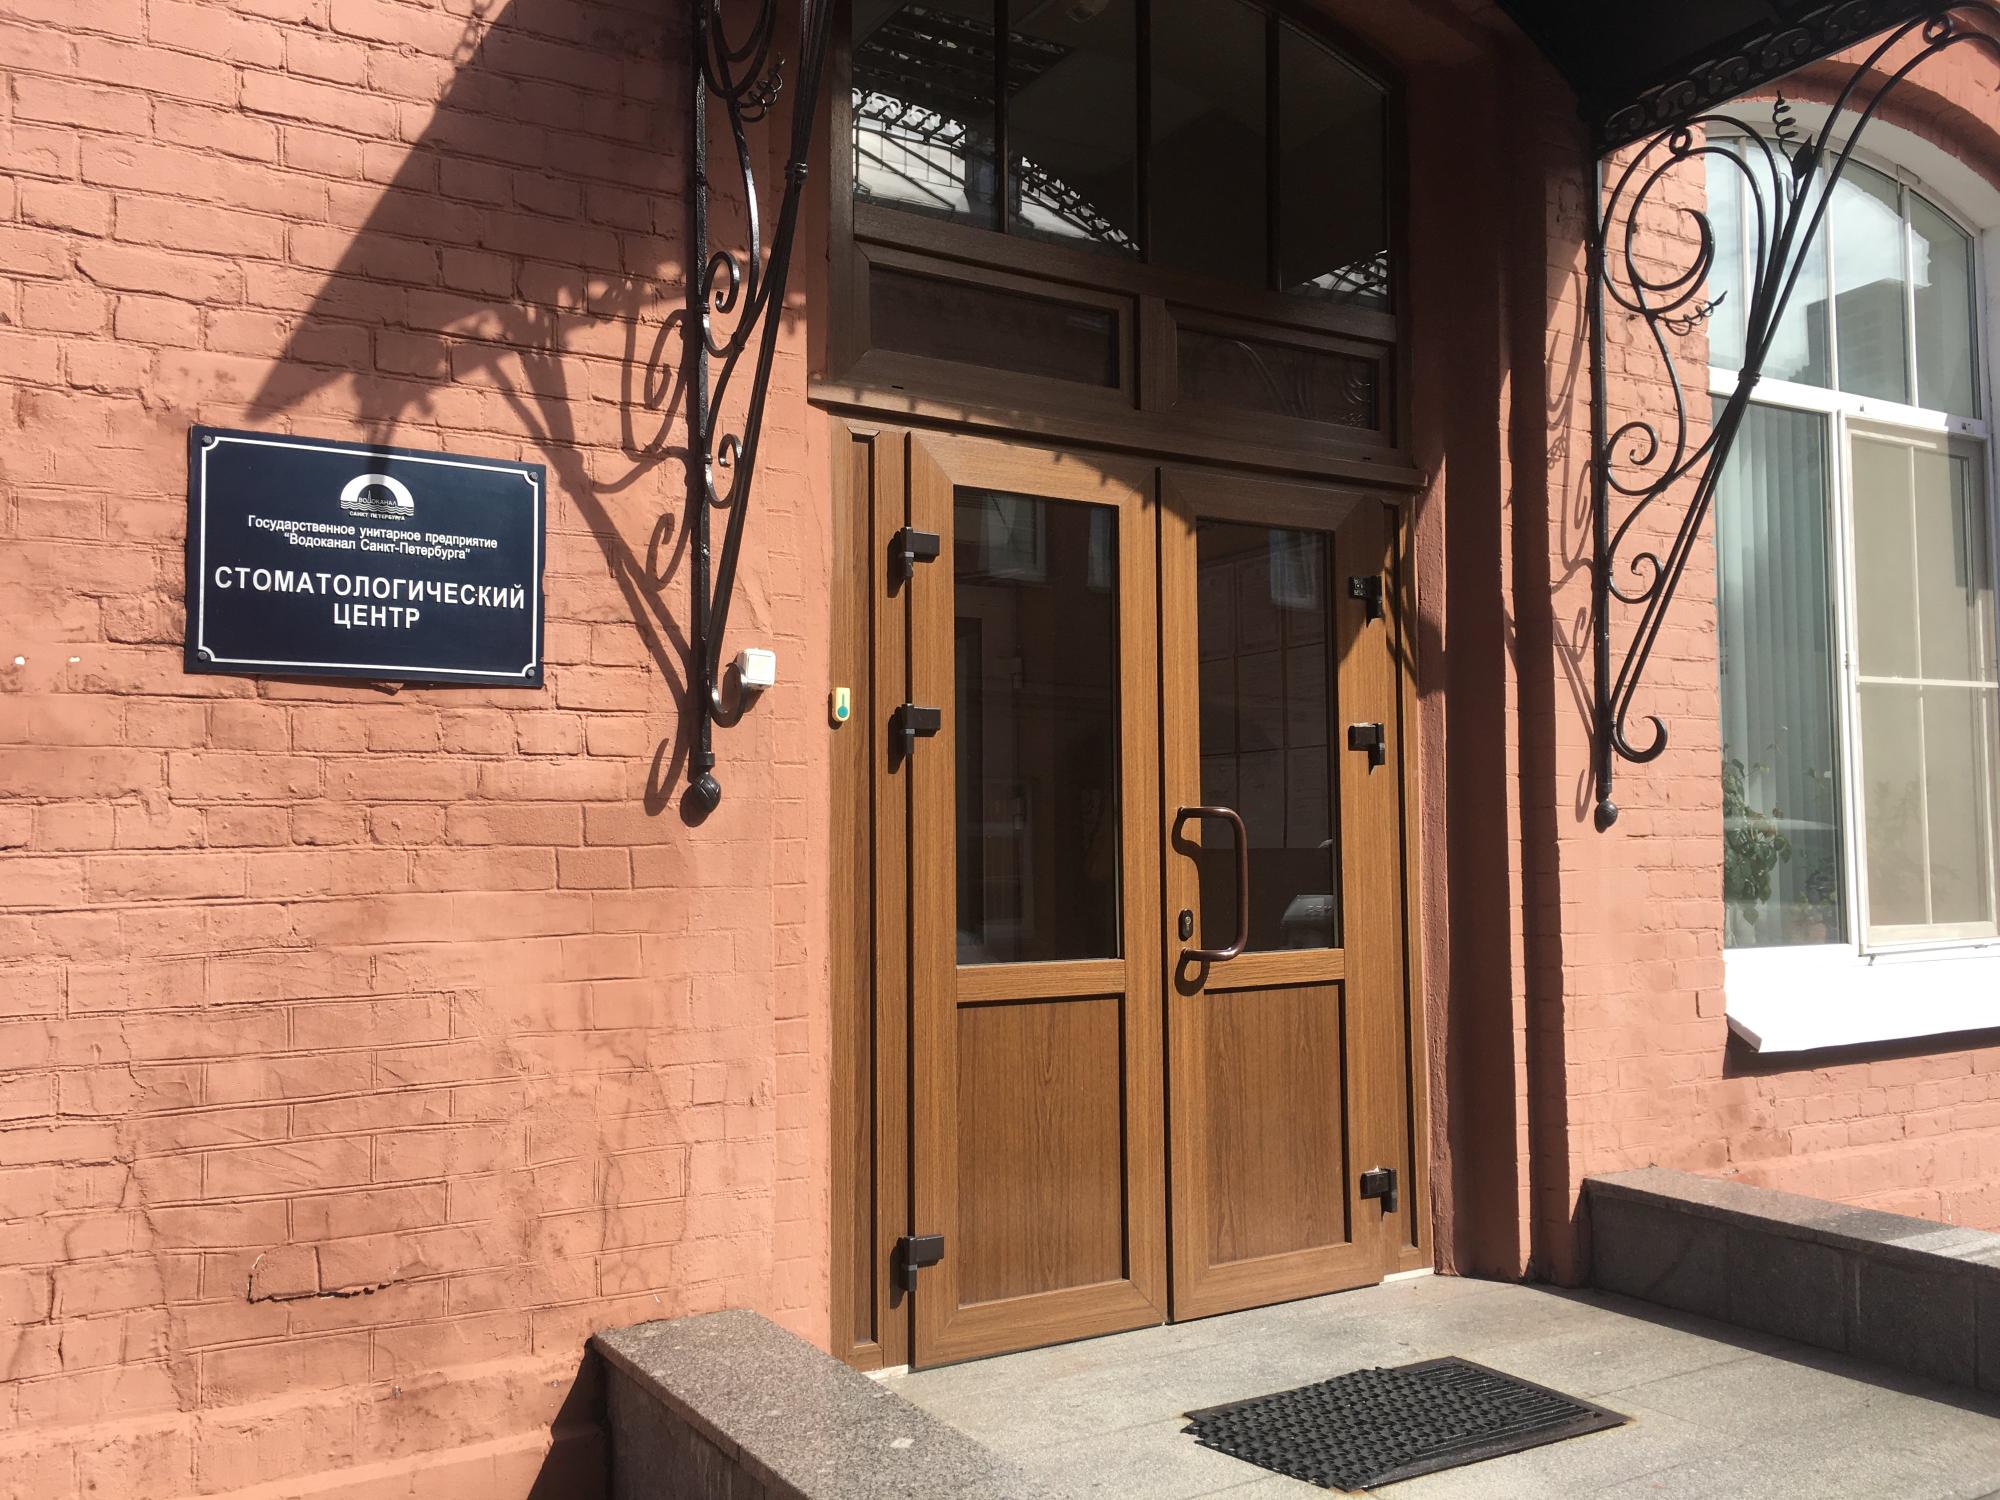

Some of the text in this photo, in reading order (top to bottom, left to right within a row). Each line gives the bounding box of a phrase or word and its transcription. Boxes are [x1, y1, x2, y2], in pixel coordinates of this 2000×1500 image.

[349, 510, 368, 518] САНКТ
[358, 496, 397, 506] ВОДОКАНАЛ
[248, 514, 498, 549] Государственное унитарное предприятие
[214, 565, 525, 609] СТОМАТОЛОГИЧЕСКИЙ
[333, 602, 420, 629] ЦЕНТР
